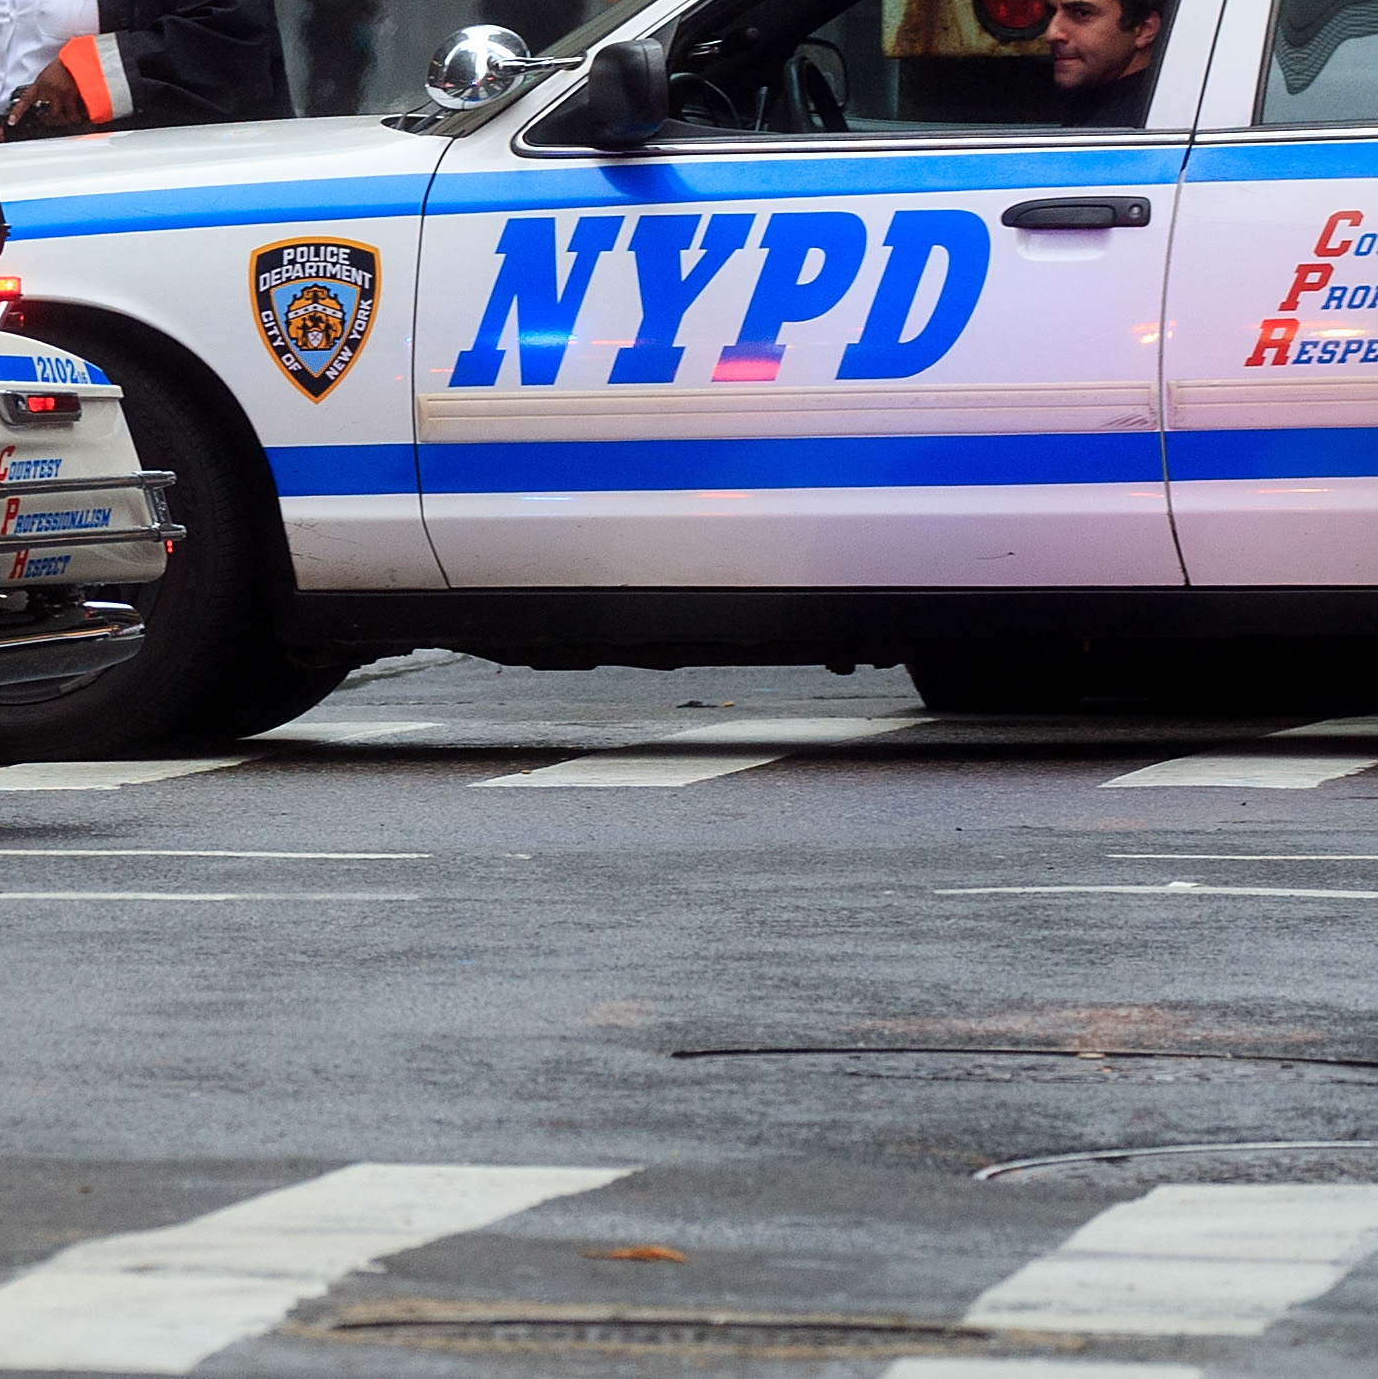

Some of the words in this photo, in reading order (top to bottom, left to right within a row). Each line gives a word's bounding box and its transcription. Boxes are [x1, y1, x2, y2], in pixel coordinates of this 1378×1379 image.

[259, 262, 372, 292] DEPARTMENT
[283, 246, 351, 265] POLICE
[447, 209, 991, 388] NYPD
[261, 310, 285, 347] CITY
[281, 353, 302, 371] OF
[325, 346, 353, 380] NEW
[349, 299, 373, 340] YORK
[37, 357, 79, 383] 2102
